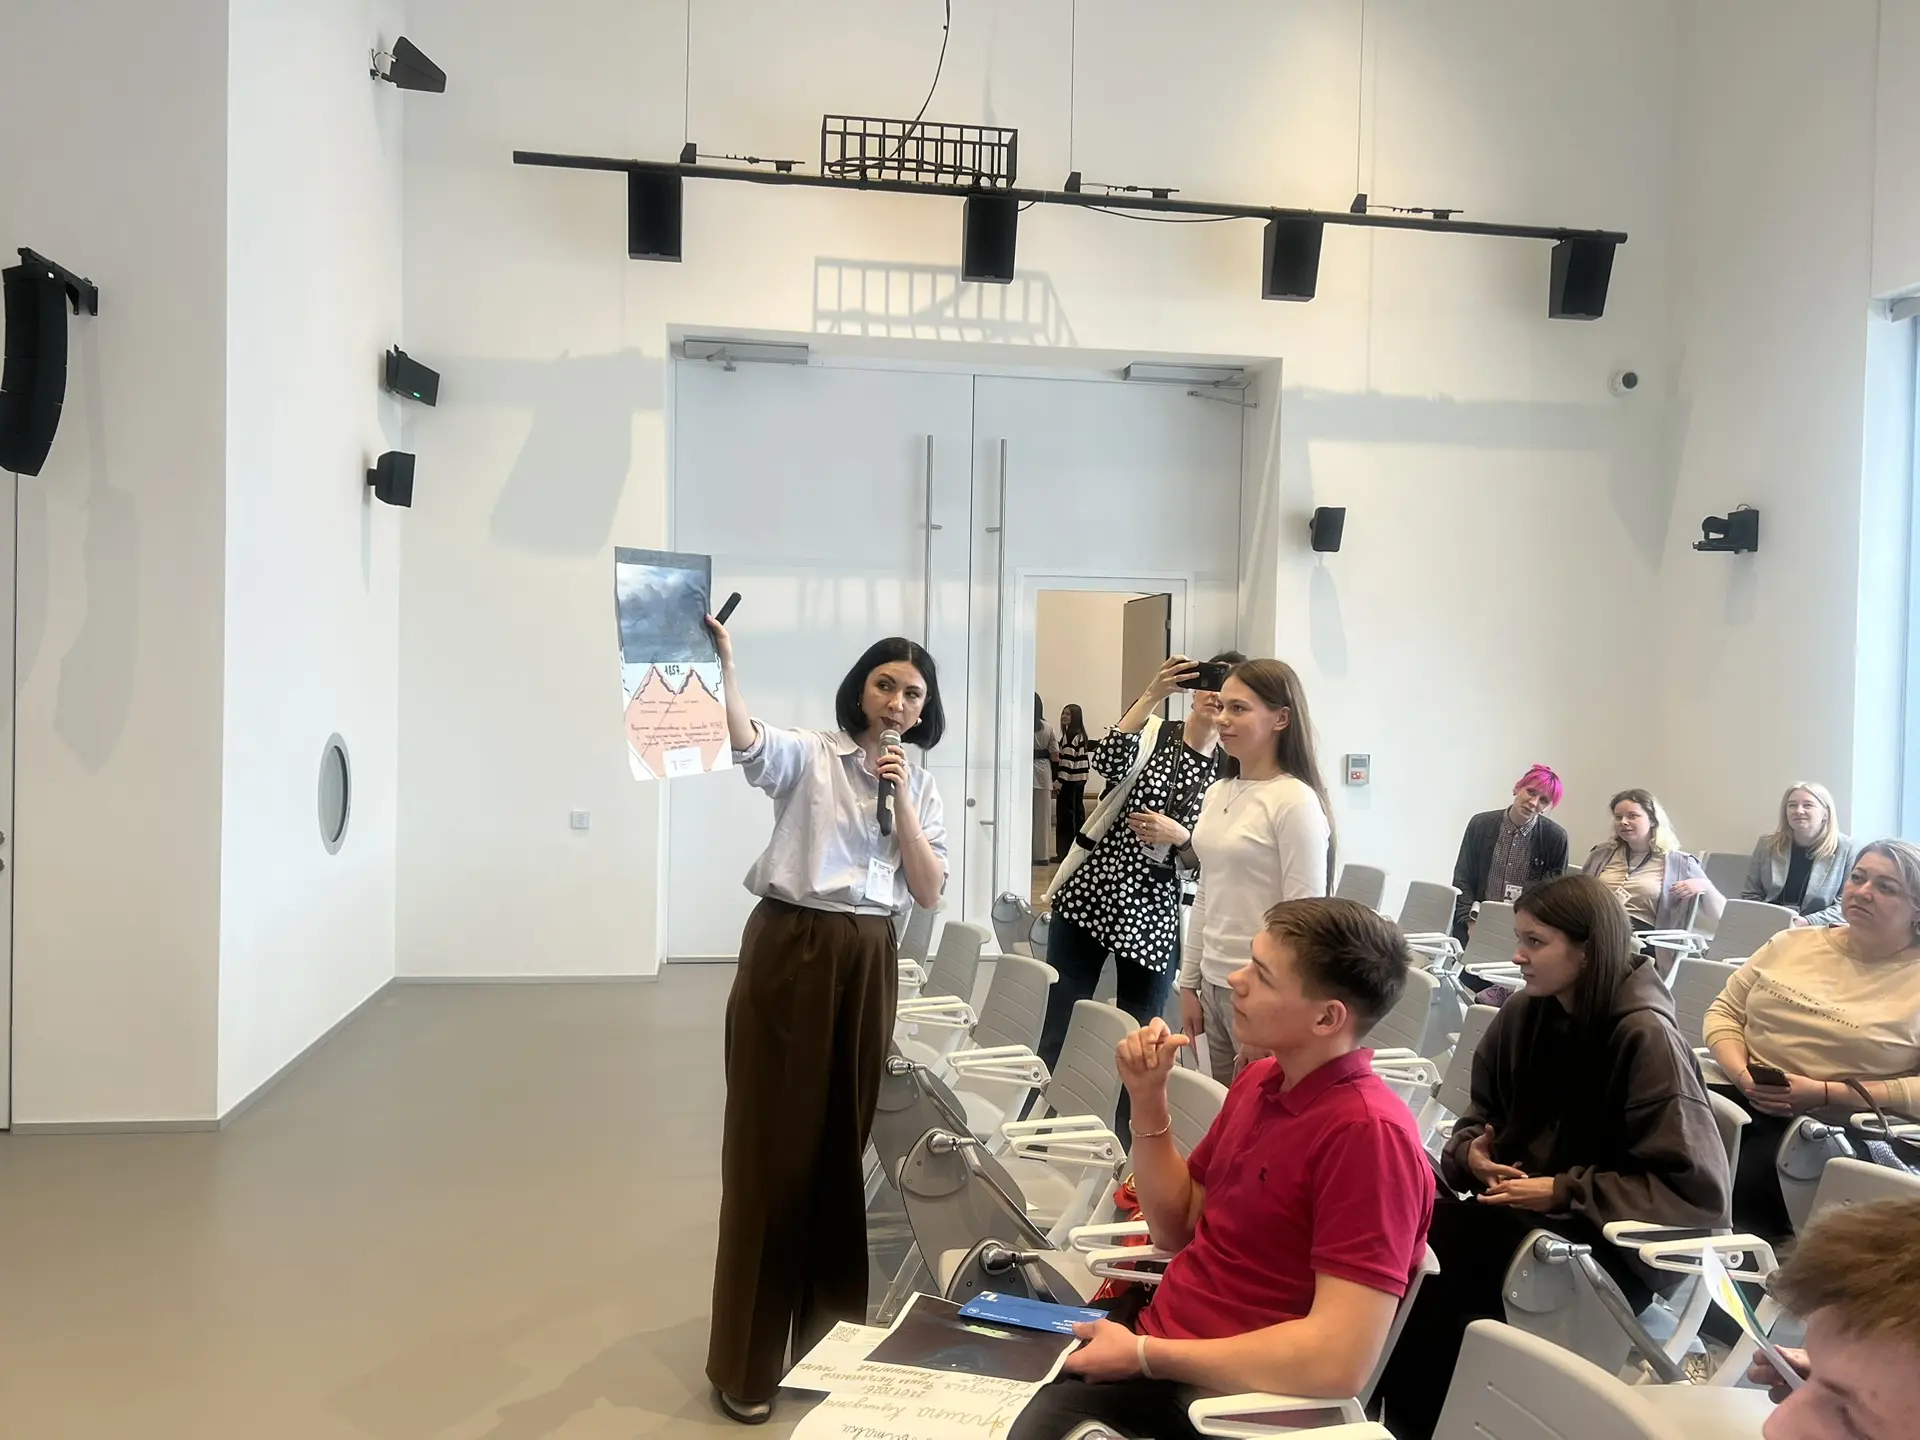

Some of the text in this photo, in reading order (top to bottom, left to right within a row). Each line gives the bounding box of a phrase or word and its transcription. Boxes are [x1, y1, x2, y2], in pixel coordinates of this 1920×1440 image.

[1799, 992, 1812, 1002] THE
[1769, 990, 1793, 1004] DECIDE
[1796, 1002, 1806, 1010] TO
[1822, 1013, 1860, 1029] YOURSELF
